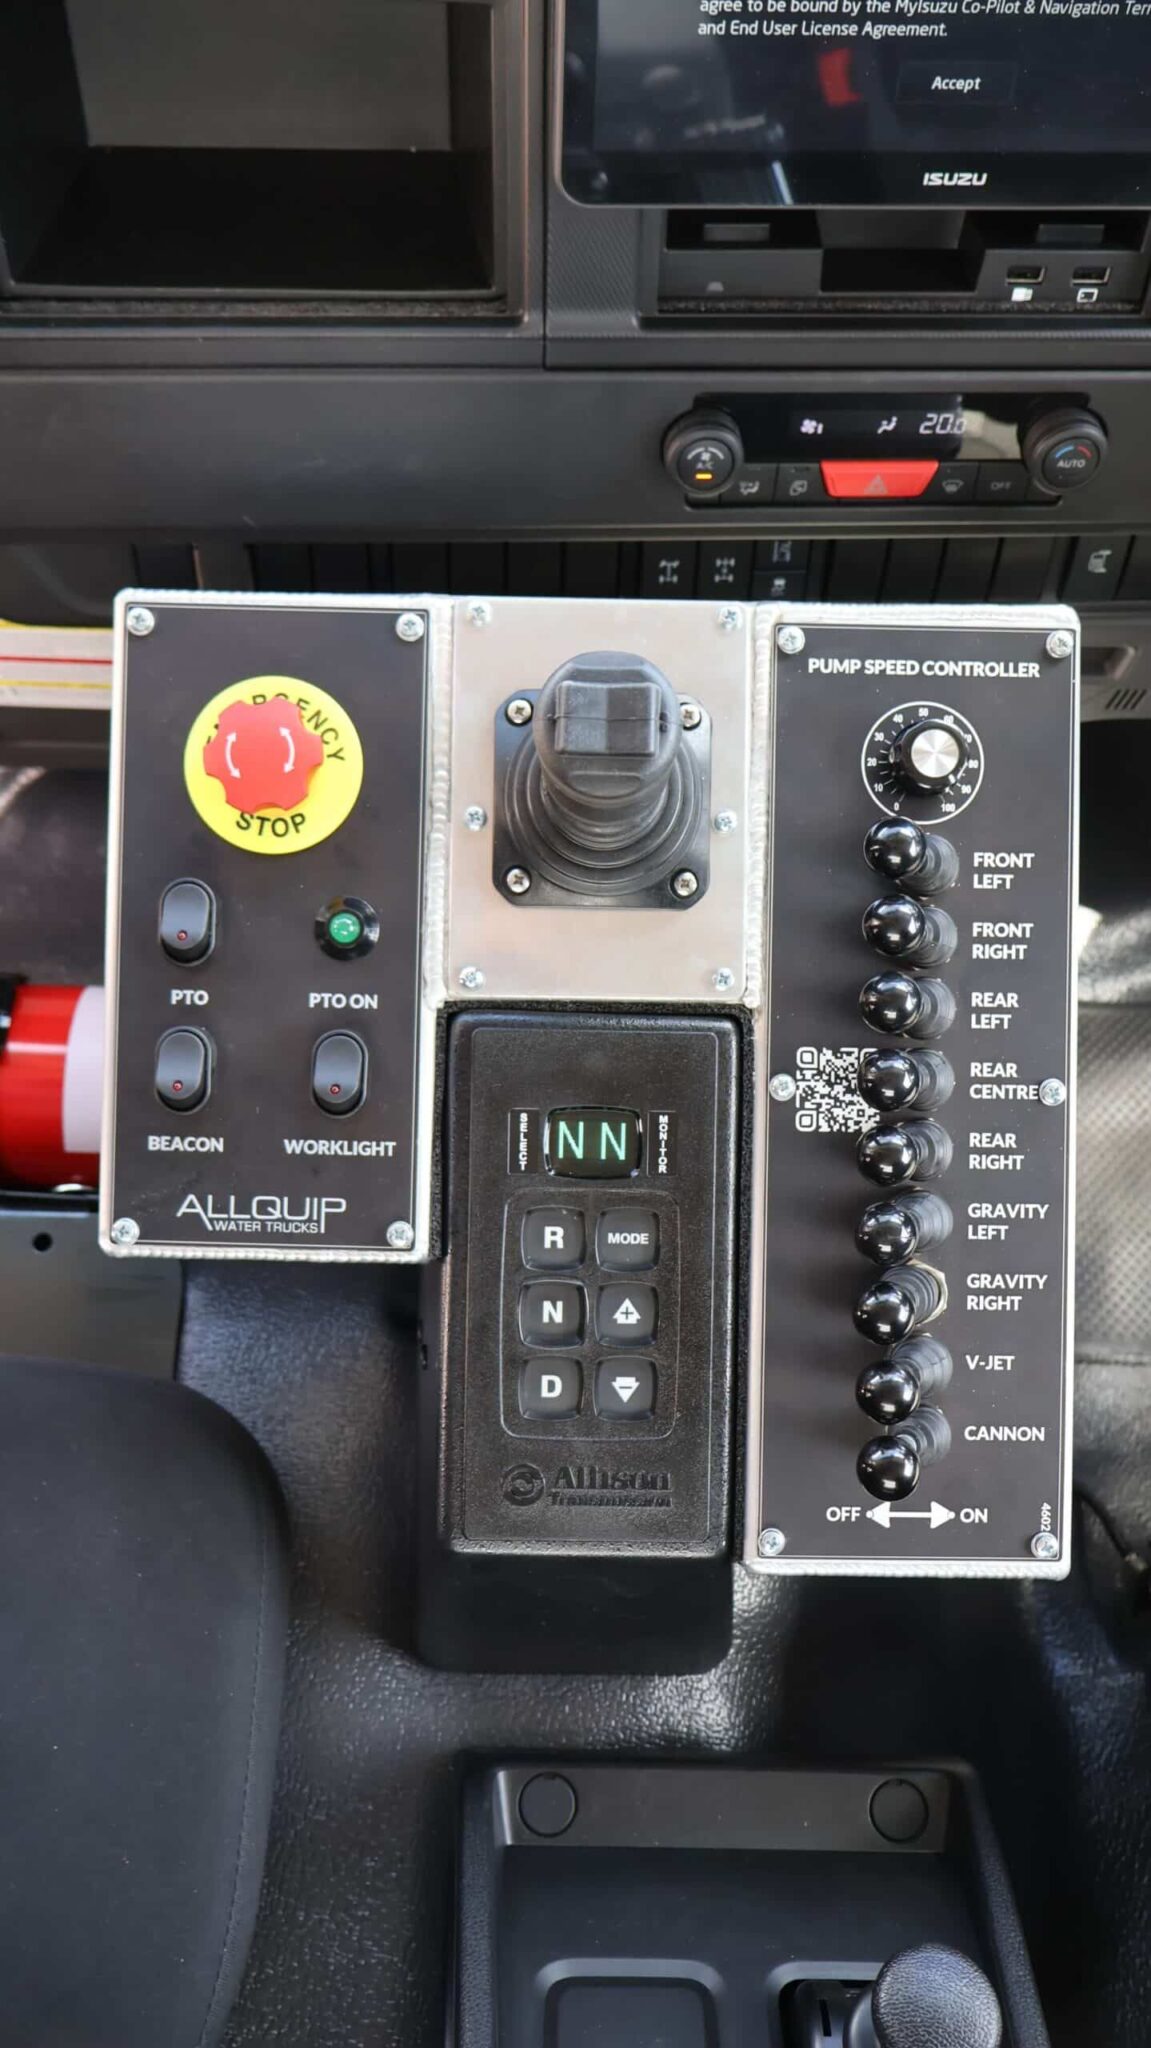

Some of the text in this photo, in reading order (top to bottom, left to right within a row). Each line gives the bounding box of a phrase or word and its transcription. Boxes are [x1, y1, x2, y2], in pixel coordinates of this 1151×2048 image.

[699, 0, 743, 15] agree
[748, 0, 763, 13] to
[767, 0, 786, 13] be
[790, 0, 844, 13] bound
[845, 0, 862, 16] by
[866, 0, 892, 13] the
[961, 0, 1021, 14] Co-Pilot
[1023, 0, 1036, 14] &
[1039, 0, 1120, 18] Navigation
[698, 20, 948, 40] and End User License Agreement.
[931, 75, 981, 93] Accept
[922, 172, 988, 186] ISUZU
[1056, 459, 1086, 468] AUTO
[808, 658, 1041, 678] PUMP SPEED CONTROLLER
[893, 714, 904, 723] 40
[918, 708, 928, 717] 50
[874, 732, 884, 741] 30
[867, 757, 877, 767] 20
[874, 783, 883, 792] 10
[961, 785, 972, 794] 90
[894, 802, 900, 811] 0
[941, 803, 956, 812] 100
[235, 811, 306, 838] STOP
[973, 852, 1035, 868] FRONT
[973, 873, 1015, 889] LEFT
[972, 922, 1034, 938] FRONT
[972, 943, 1028, 960] RIGHT
[170, 990, 209, 1006] PTO
[308, 993, 379, 1010] PTO ON
[971, 992, 1019, 1008] REAR
[971, 1013, 1011, 1029] LEFT
[970, 1062, 1018, 1078] REAR
[969, 1083, 1039, 1100] CENTRE
[147, 1135, 224, 1153] BEACON
[283, 1138, 397, 1157] WORKLIGHT
[518, 1113, 529, 1171] SELECT
[658, 1115, 669, 1174] MONITOR
[969, 1132, 1017, 1149] REAR
[968, 1154, 1025, 1171] RIGHT
[176, 1194, 347, 1234] ALLQUIP
[967, 1203, 1049, 1220] GRAVITY
[214, 1220, 318, 1234] WATER TRUCKS
[967, 1224, 1009, 1241] LEFT
[543, 1226, 564, 1249] R
[607, 1232, 649, 1245] MODE
[966, 1273, 1048, 1290] GRAVITY
[966, 1295, 1022, 1311] RIGHT
[543, 1301, 564, 1324] N
[965, 1354, 1015, 1371] V-JET
[540, 1374, 562, 1398] D
[963, 1425, 1046, 1442] CANNON
[825, 1507, 862, 1522] OFF
[959, 1508, 988, 1523] ON
[1040, 1502, 1052, 1532] 4602
